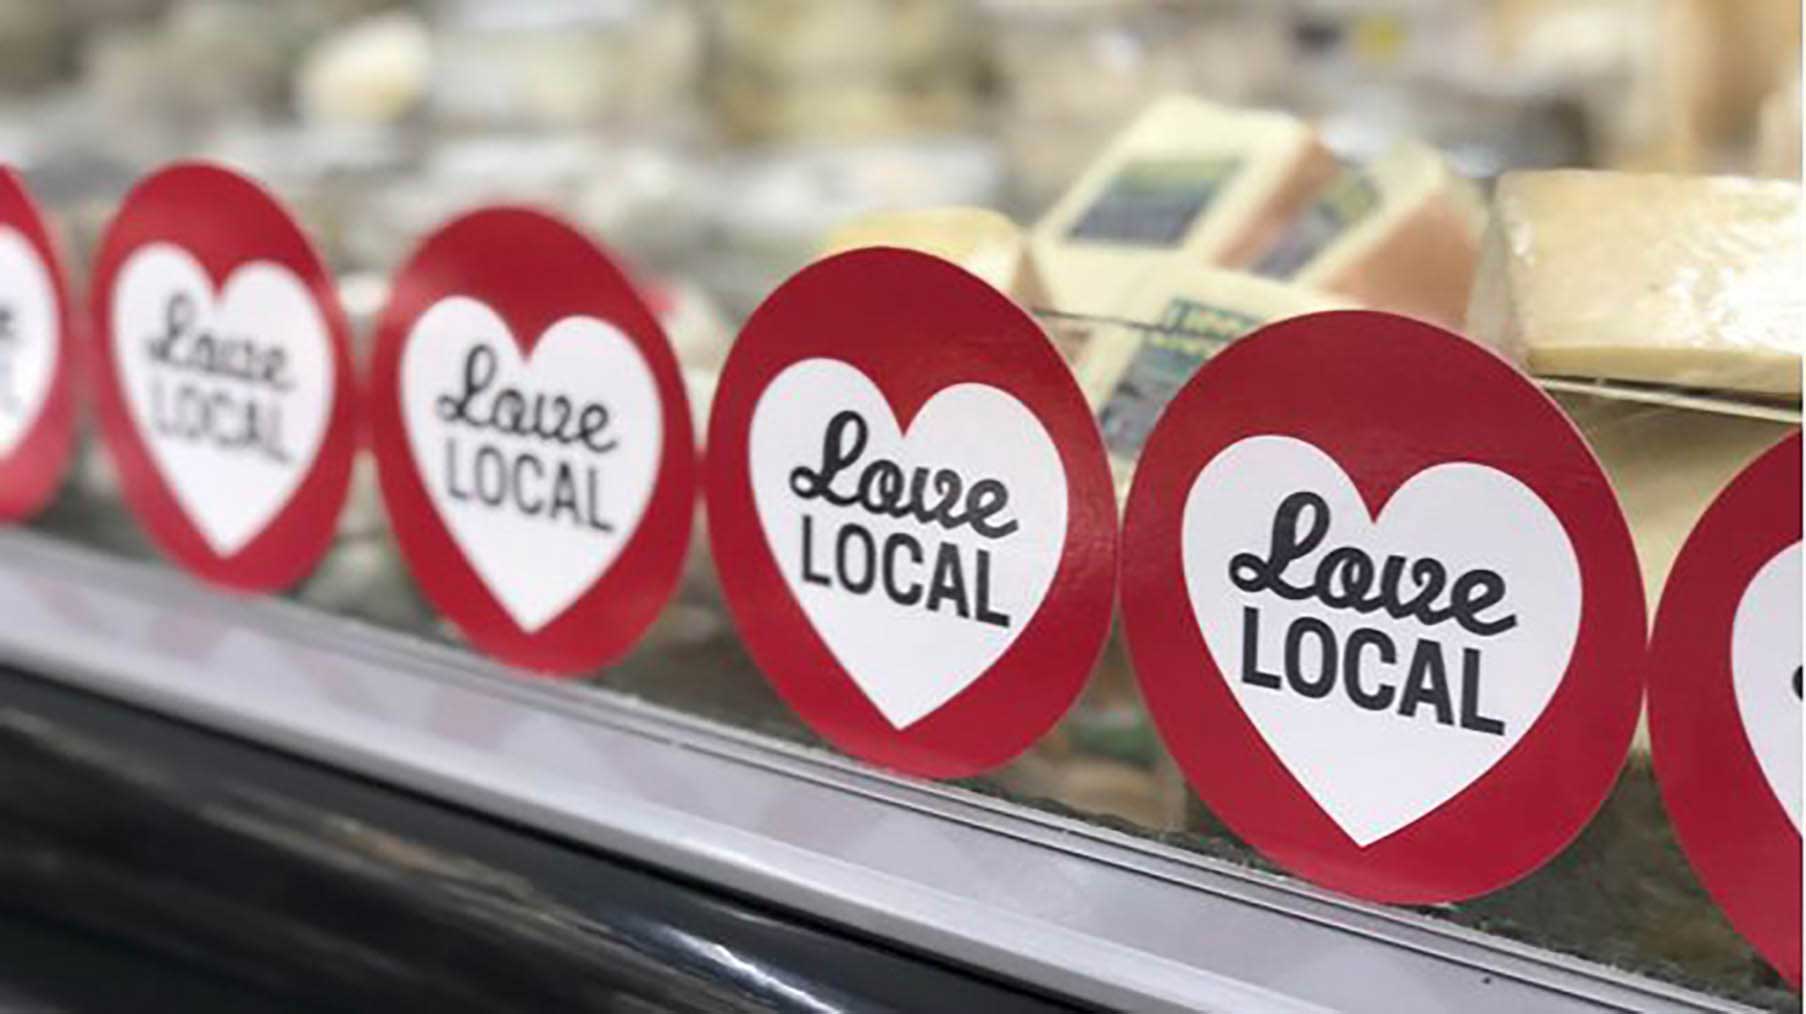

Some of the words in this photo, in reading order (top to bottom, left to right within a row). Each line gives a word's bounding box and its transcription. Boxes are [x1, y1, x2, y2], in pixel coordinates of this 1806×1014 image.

[437, 343, 617, 453] Love
[446, 437, 614, 533] LOCAL
[789, 410, 1019, 539] Love
[802, 514, 1011, 628] LOCAL
[1228, 491, 1518, 637] Love
[1241, 605, 1506, 737] LOCAL
